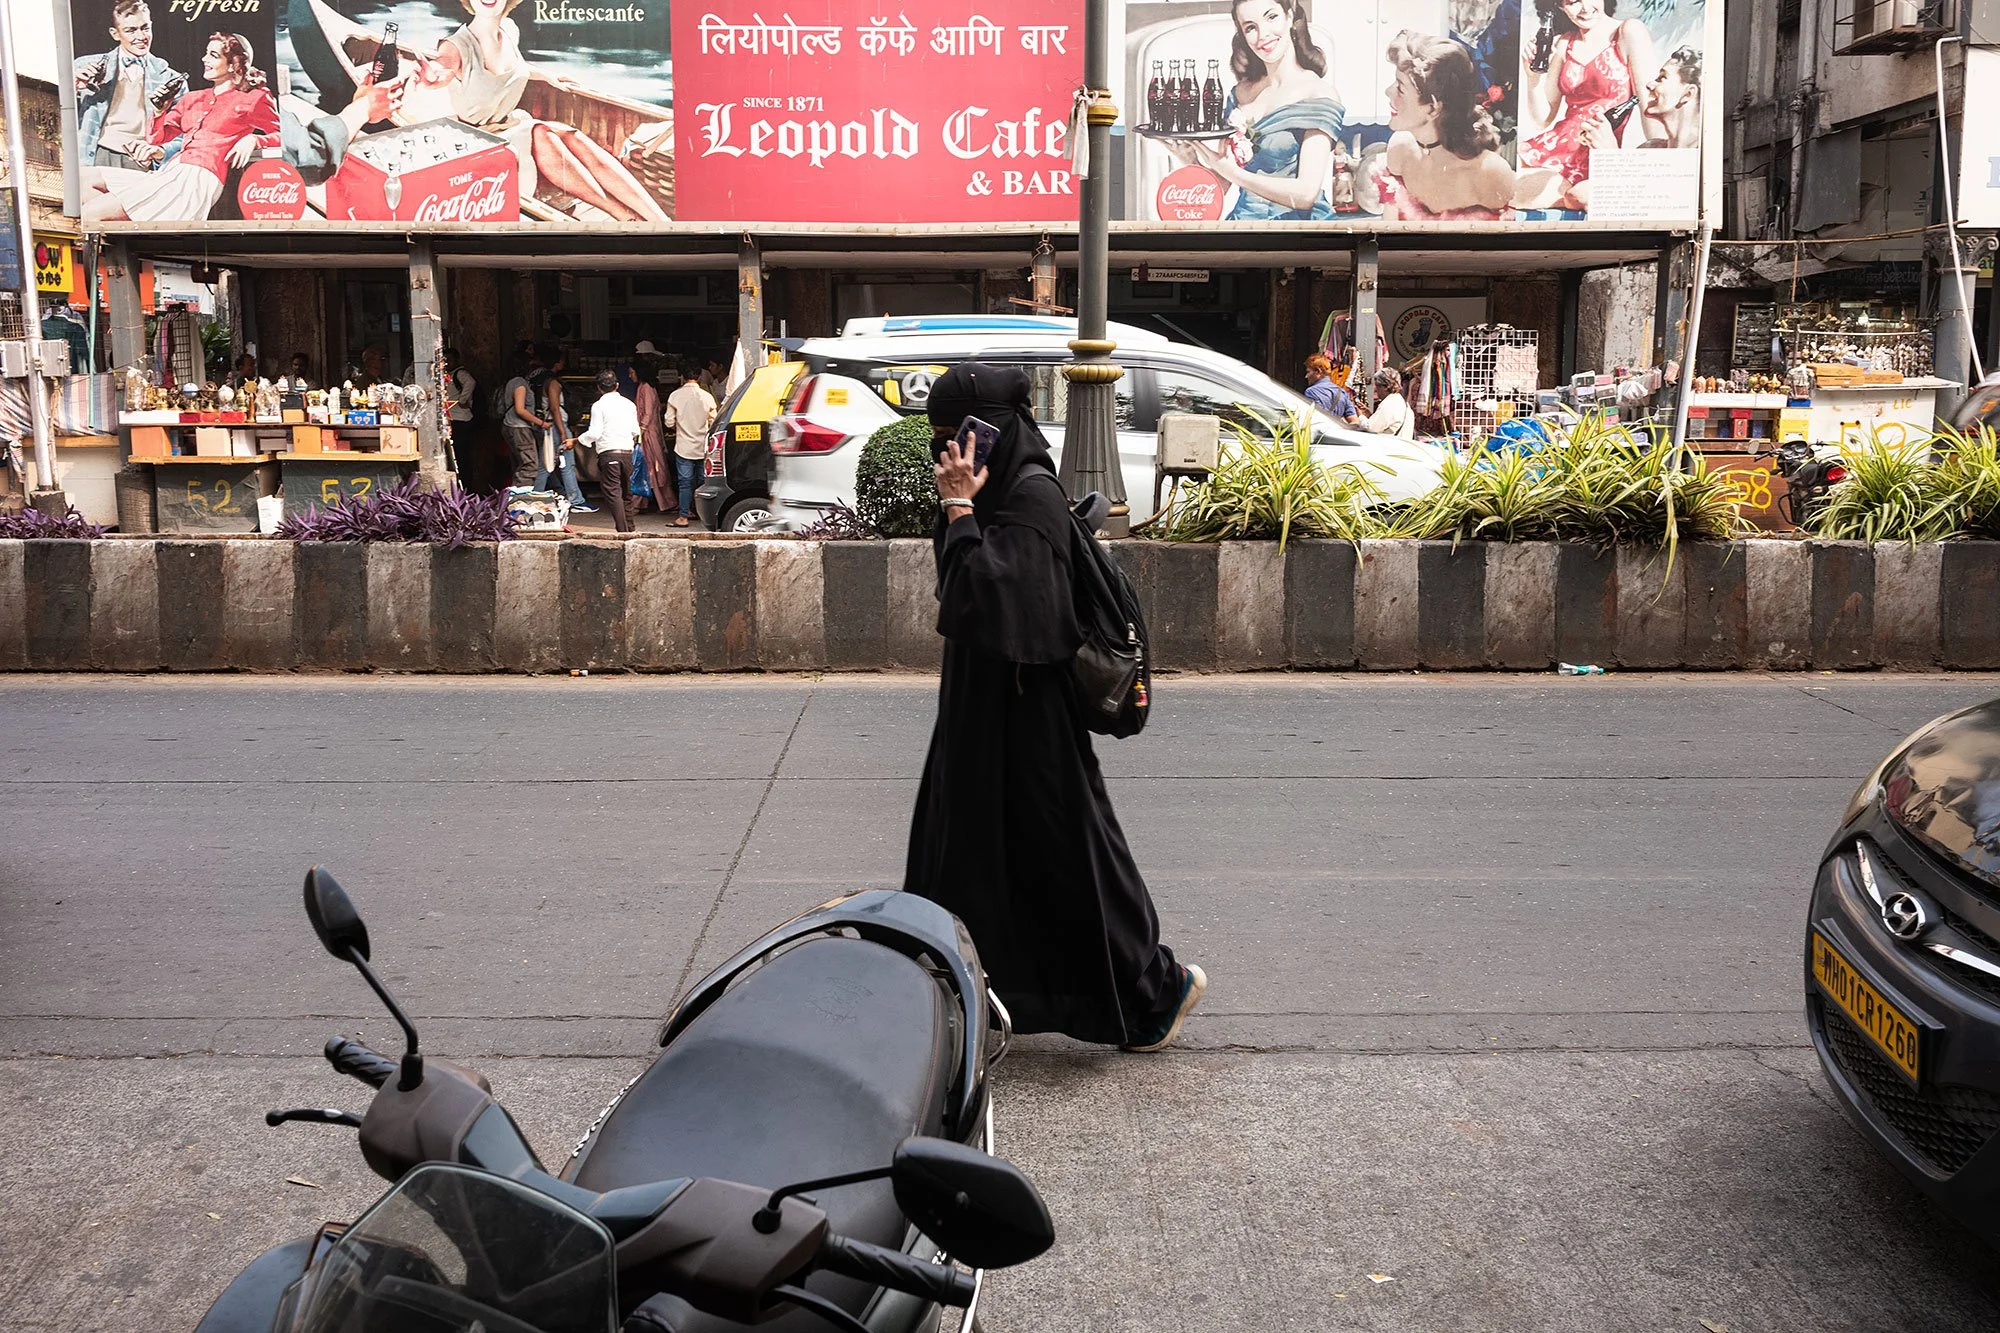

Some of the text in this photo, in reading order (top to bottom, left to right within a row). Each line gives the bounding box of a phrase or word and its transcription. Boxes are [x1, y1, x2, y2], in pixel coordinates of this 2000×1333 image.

[169, 0, 259, 22] refresh
[535, 0, 645, 22] Refrescante
[698, 12, 1069, 56] लियोपोल्ड कॅफे आणि बार
[743, 96, 825, 112] SINCE 1871
[694, 102, 1067, 168] Leopold Cafe
[449, 171, 473, 187] TOME
[966, 170, 1073, 196] & BAR
[242, 182, 301, 204] Coca-Cola
[413, 169, 510, 222] Coca-Cola
[1161, 183, 1217, 205] Coca-Cola
[1398, 309, 1430, 330] LEOPOLD
[187, 479, 241, 513] 52
[1823, 946, 1916, 1070] MH01CR1260
